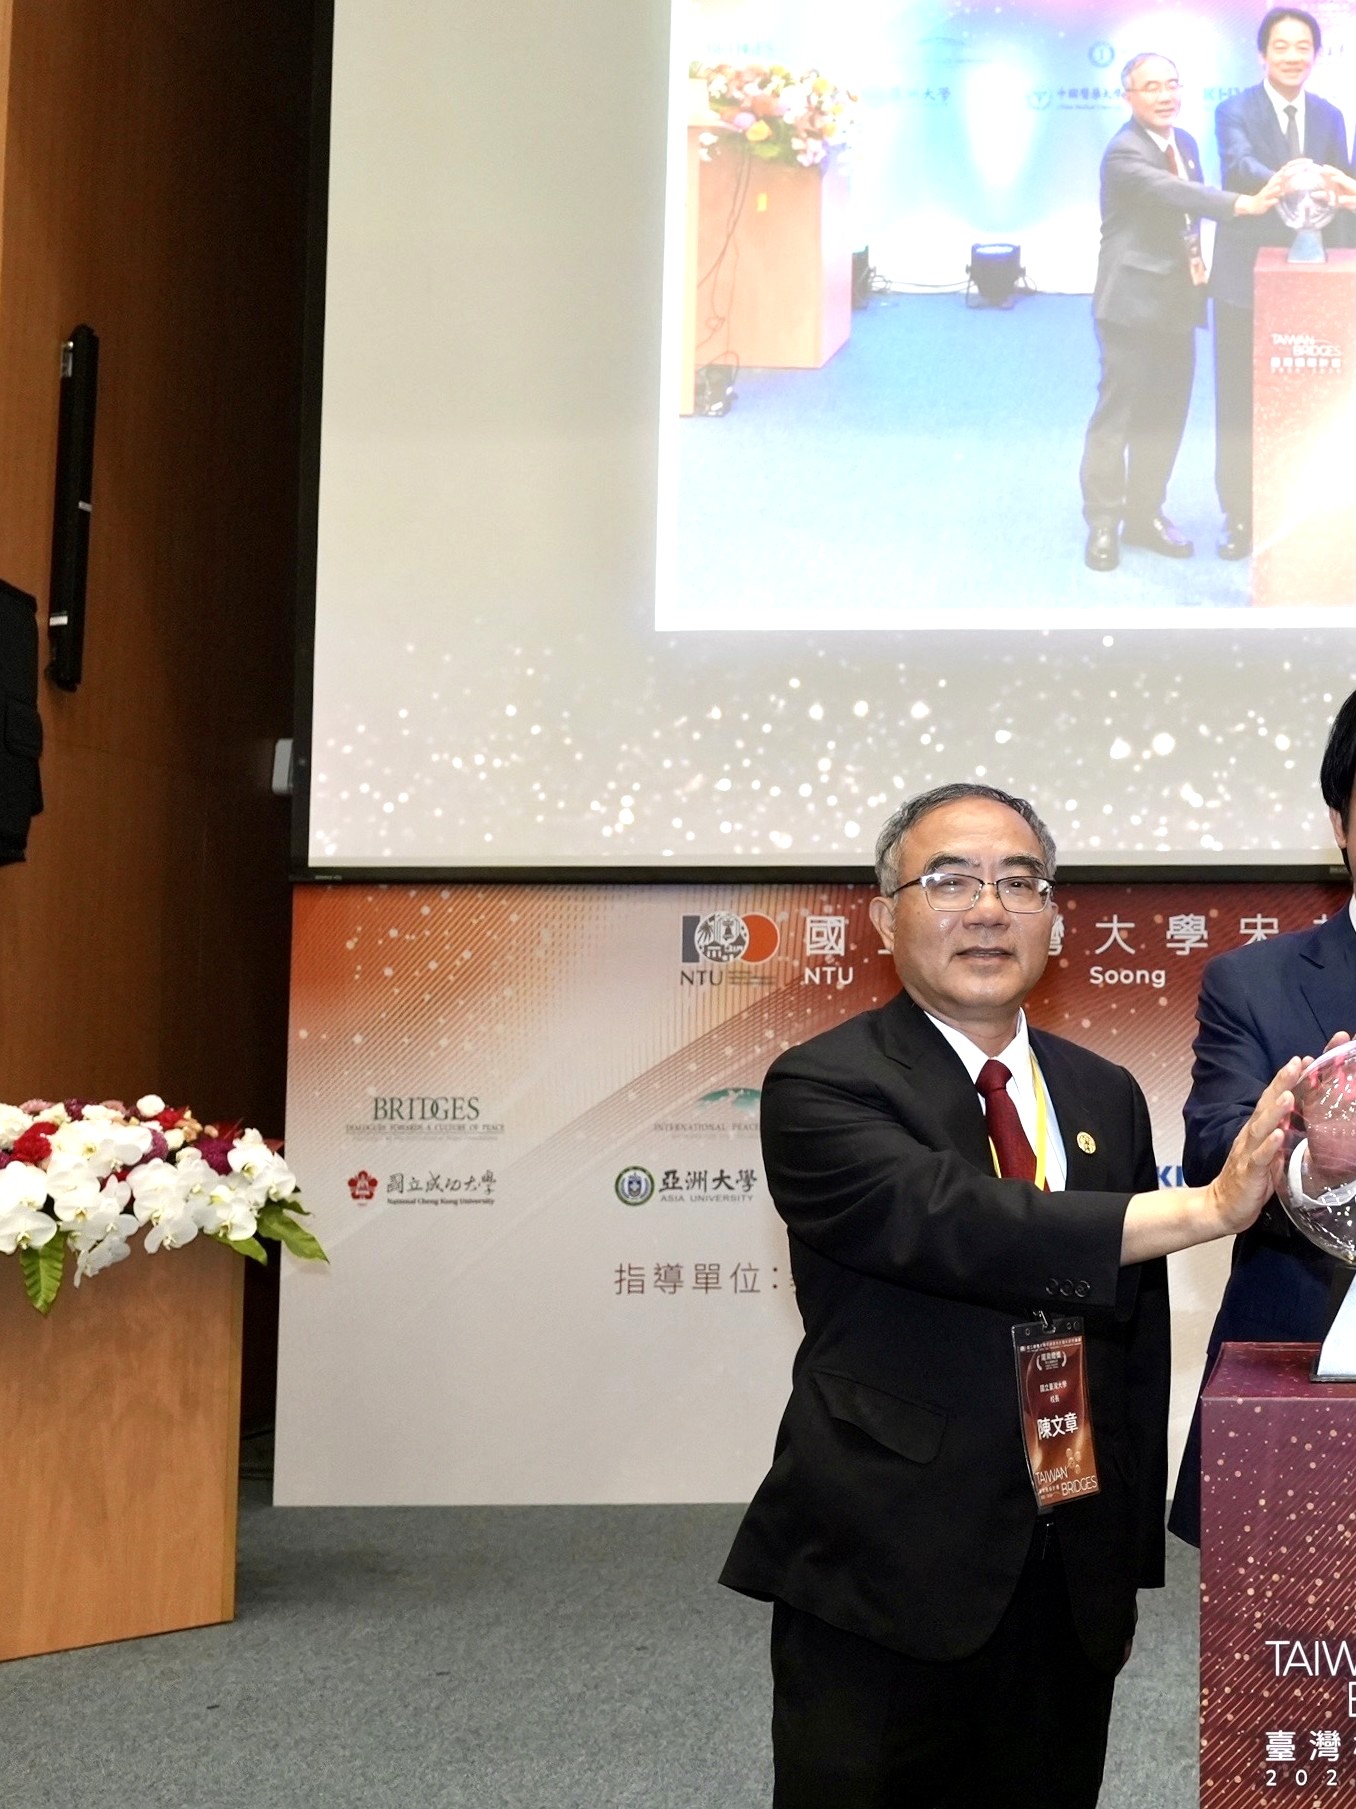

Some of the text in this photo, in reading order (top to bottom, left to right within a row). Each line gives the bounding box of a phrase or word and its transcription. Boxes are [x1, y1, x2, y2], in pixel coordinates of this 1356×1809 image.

[680, 970, 723, 986] NTU
[805, 967, 854, 985] NTU
[1089, 966, 1166, 988] Soong
[373, 1096, 480, 1120] BRIDGES
[387, 1169, 496, 1195] 國立成功大學
[659, 1168, 757, 1193] 亞洲大學
[661, 1194, 754, 1203] ASIA UNIVERSITY
[1037, 1412, 1078, 1440] 陳文章
[1035, 1466, 1068, 1484] TAIWAN
[1061, 1475, 1097, 1496] BRIDGES
